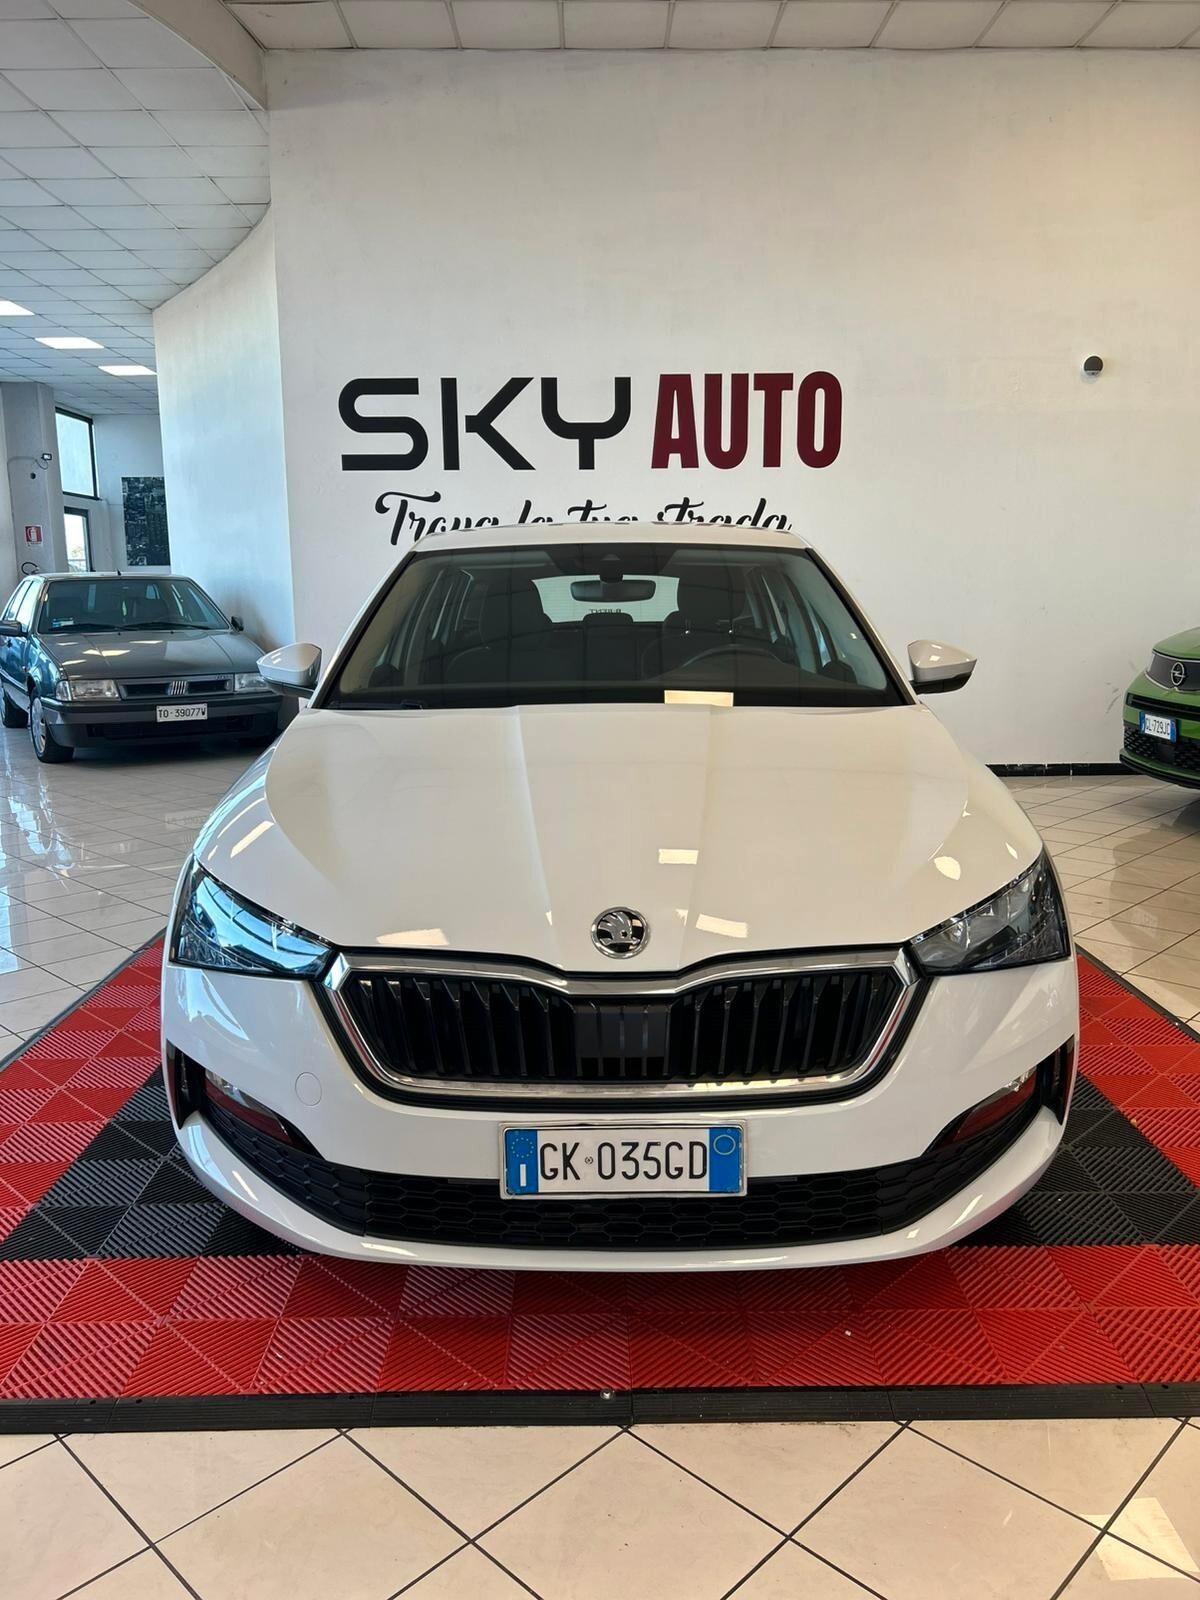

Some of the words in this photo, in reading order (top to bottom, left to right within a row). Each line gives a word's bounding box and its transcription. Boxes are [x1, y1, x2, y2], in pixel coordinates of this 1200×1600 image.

[338, 377, 632, 471] SKY
[651, 371, 842, 470] AUTO
[540, 1142, 580, 1181] GK
[597, 1141, 708, 1181] 035GD
